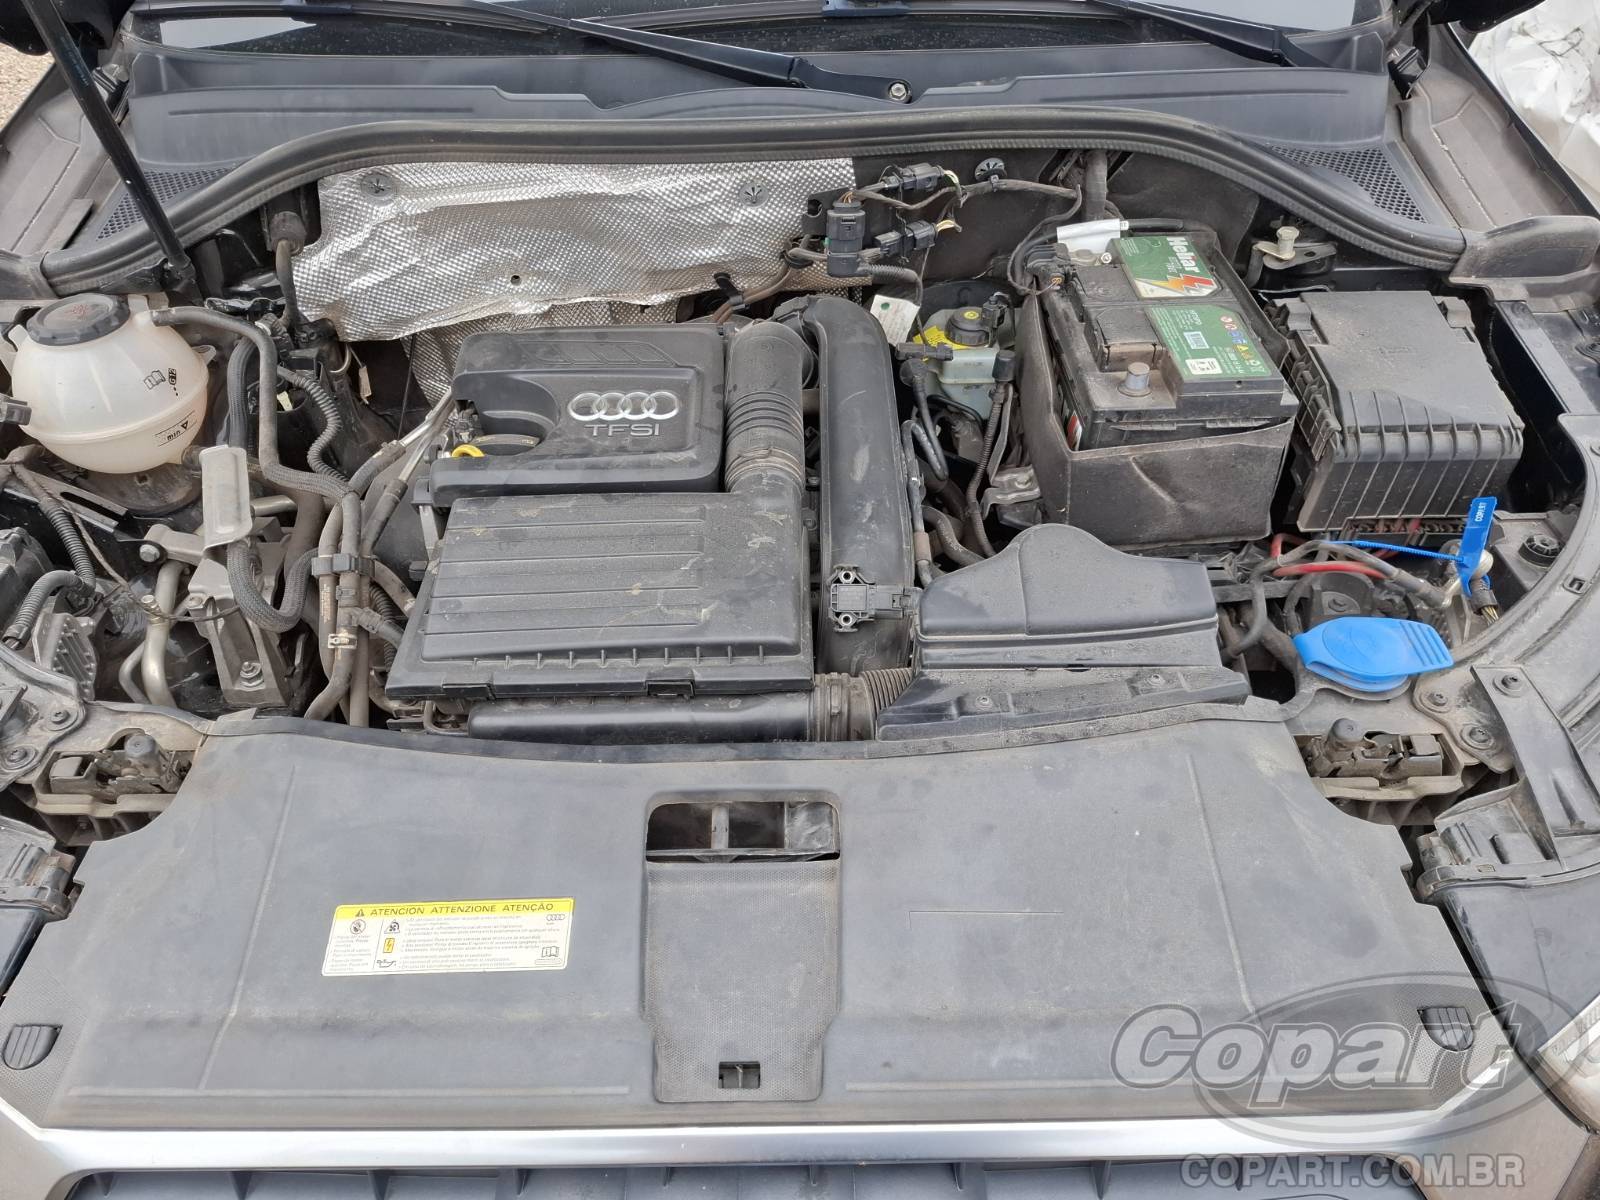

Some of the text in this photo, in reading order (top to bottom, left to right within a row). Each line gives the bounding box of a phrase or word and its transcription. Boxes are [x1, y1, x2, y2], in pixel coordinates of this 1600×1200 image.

[1166, 236, 1201, 273] Heliar
[166, 430, 181, 441] min
[584, 423, 660, 436] TFSI
[430, 904, 497, 914] ATTENZIONE
